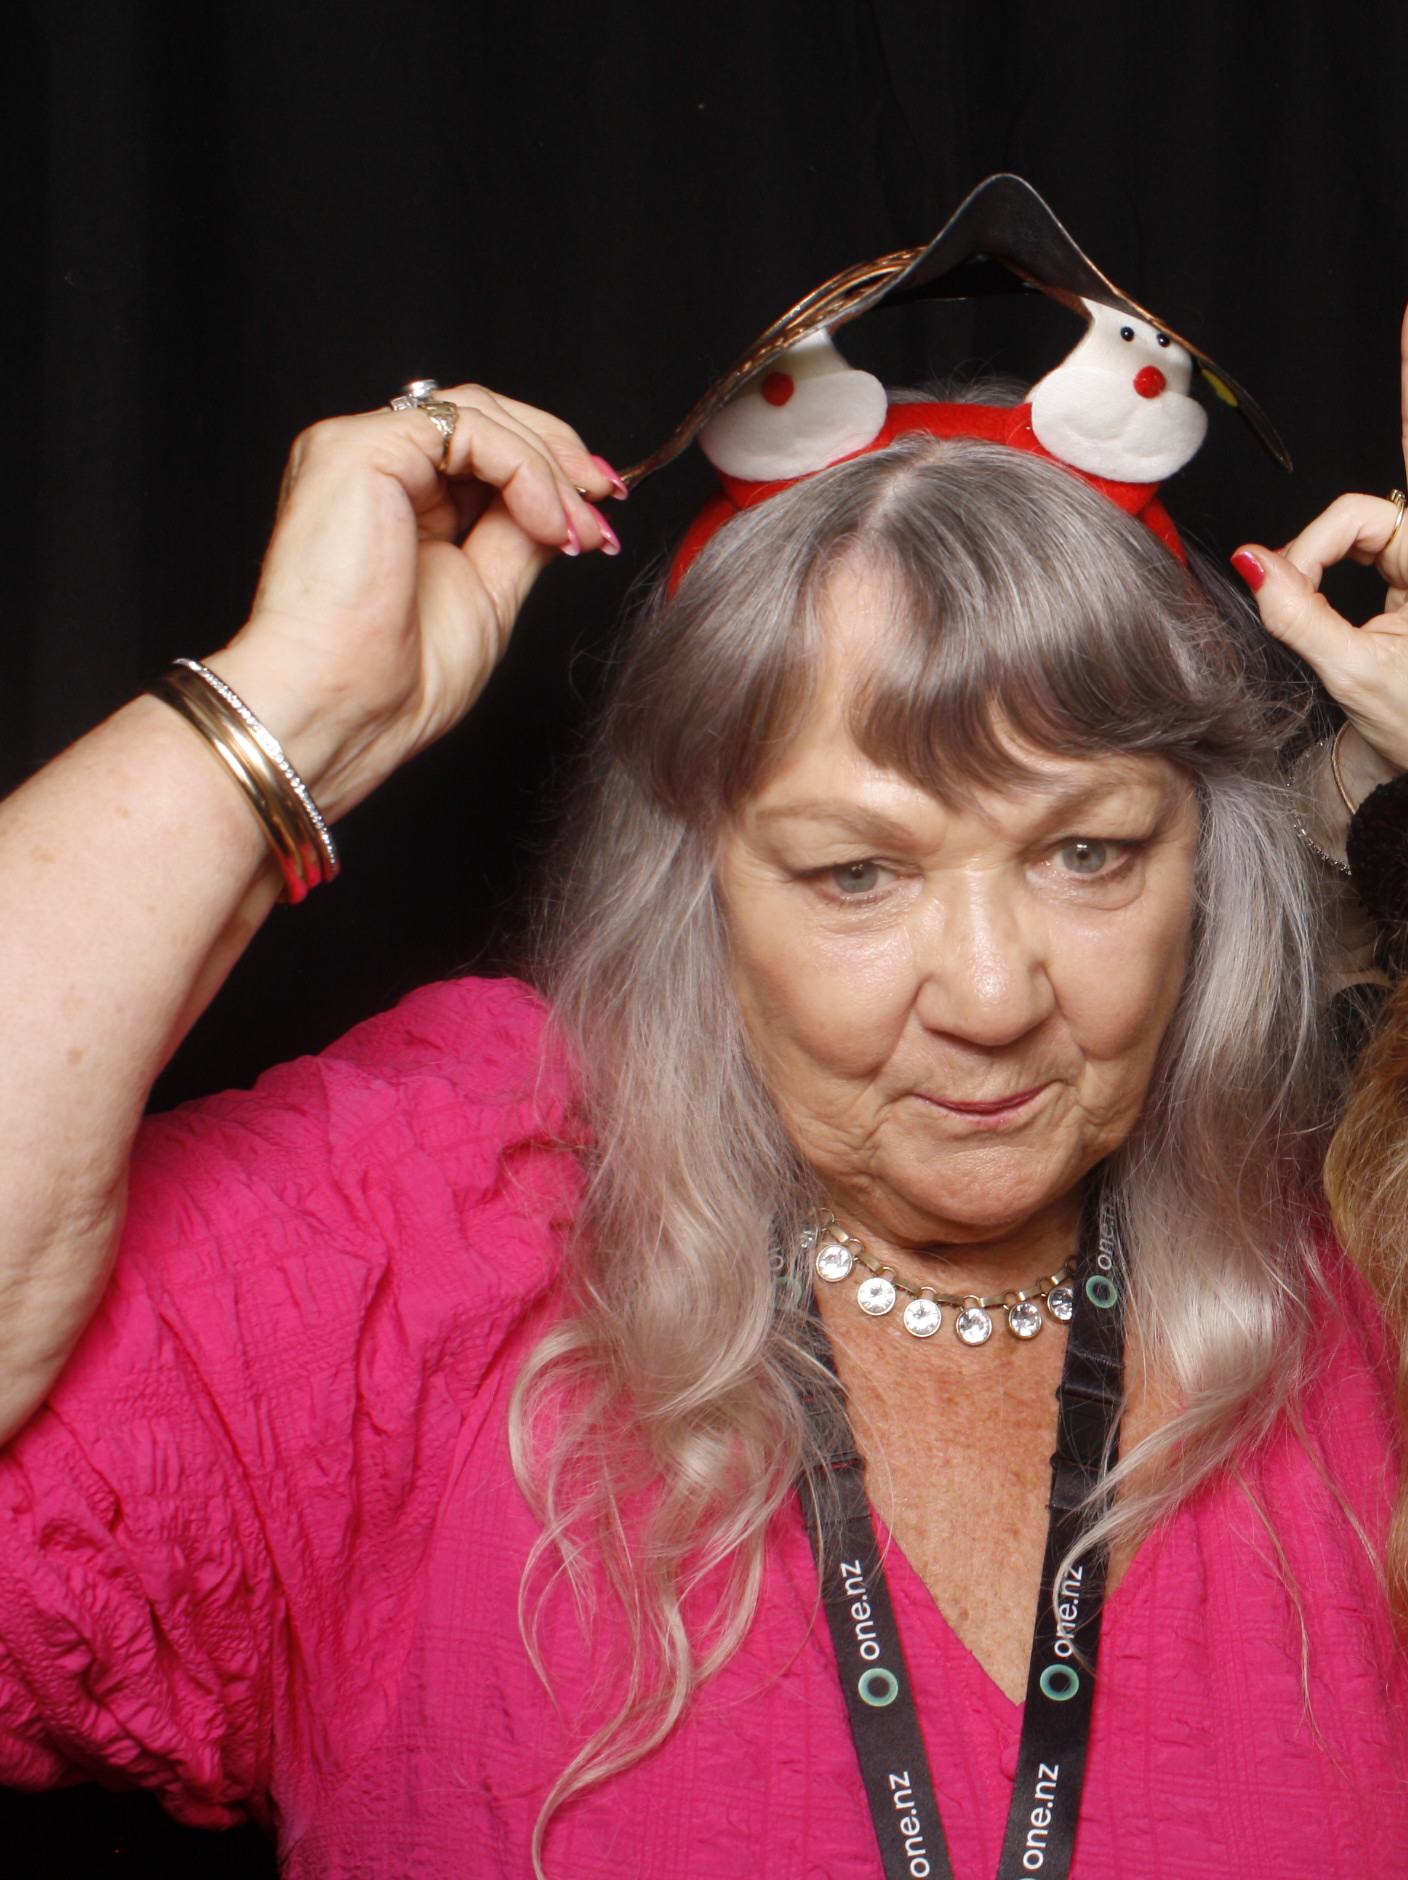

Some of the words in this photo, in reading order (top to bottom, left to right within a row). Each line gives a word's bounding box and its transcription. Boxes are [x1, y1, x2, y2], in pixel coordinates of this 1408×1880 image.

[840, 1559, 880, 1660] one.nz
[1053, 1565, 1083, 1658] one.nz
[889, 1770, 930, 1878] one.nz
[1022, 1763, 1059, 1870] one.nz
